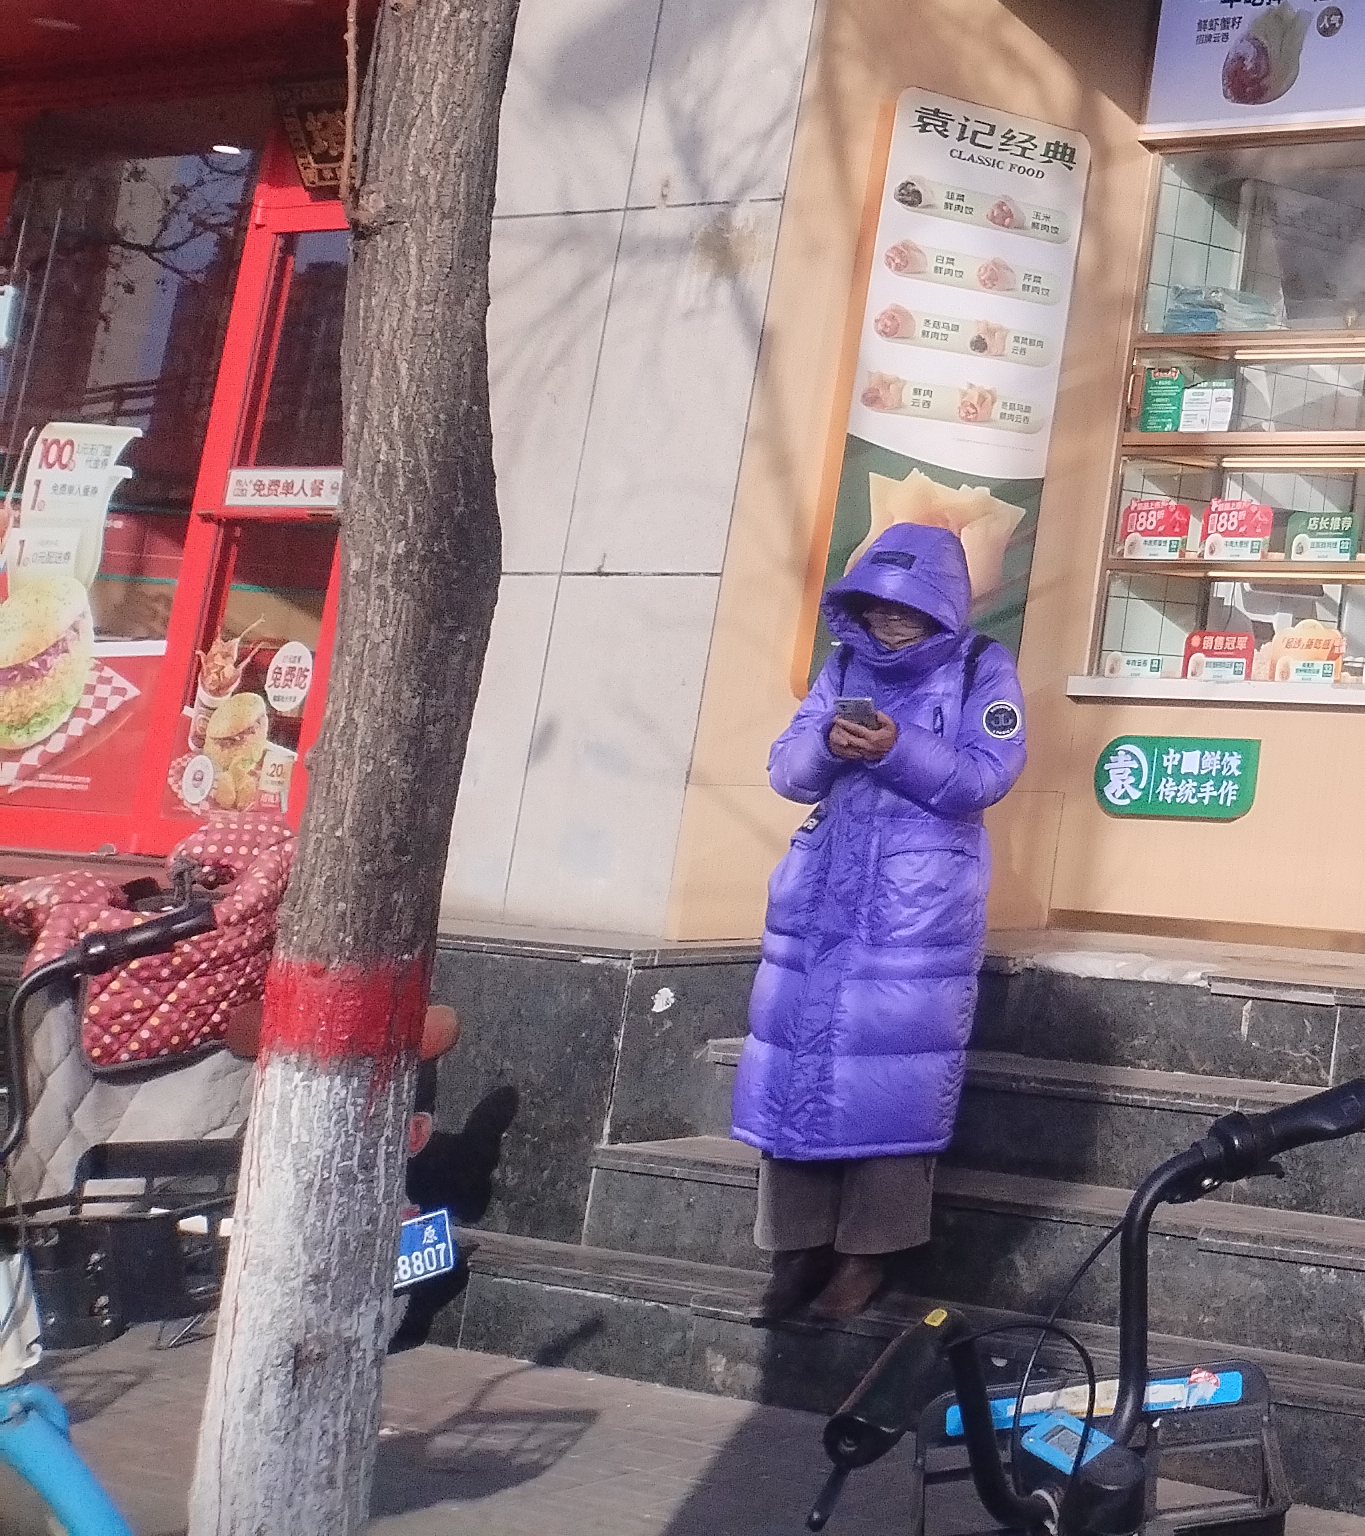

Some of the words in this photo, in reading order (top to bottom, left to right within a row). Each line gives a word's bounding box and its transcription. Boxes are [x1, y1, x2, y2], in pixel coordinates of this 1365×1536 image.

[1196, 15, 1244, 33] 鲜虾蟹籽
[910, 104, 1079, 172] 袁记经典
[948, 148, 1006, 172] CLASSIC
[1009, 162, 1046, 180] FOOD
[251, 478, 325, 498] 免费单人餐
[1306, 516, 1354, 532] 店长推荐
[268, 665, 311, 691] 免费吃
[1155, 777, 1240, 807] 传统手作
[394, 1242, 447, 1282] 8807
